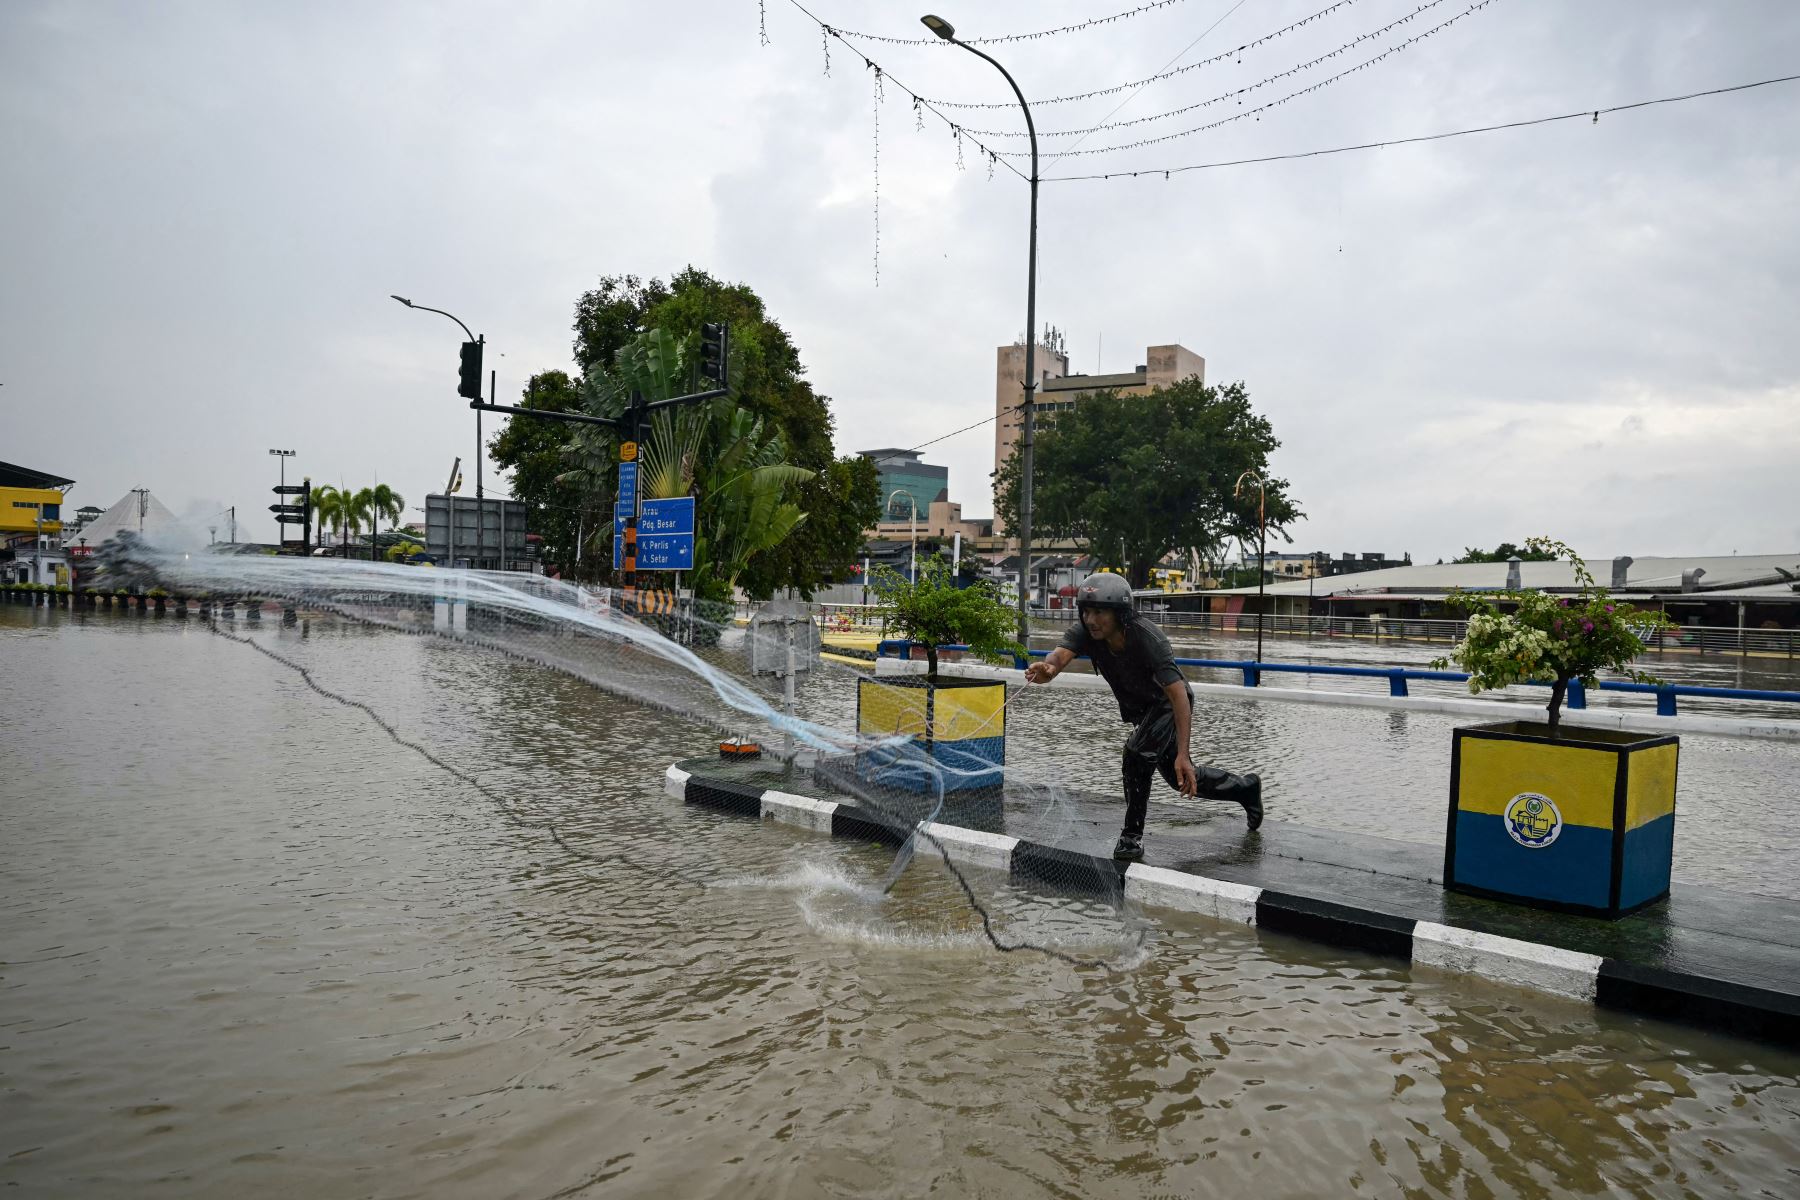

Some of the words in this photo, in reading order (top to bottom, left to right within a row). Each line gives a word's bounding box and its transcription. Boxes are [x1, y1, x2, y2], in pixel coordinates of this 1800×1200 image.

[642, 507, 659, 516] Arau
[642, 520, 656, 531] Pdg.
[657, 519, 676, 529] Besar
[649, 540, 669, 549] Perlis
[642, 554, 649, 563] A.
[650, 554, 668, 563] Setar
